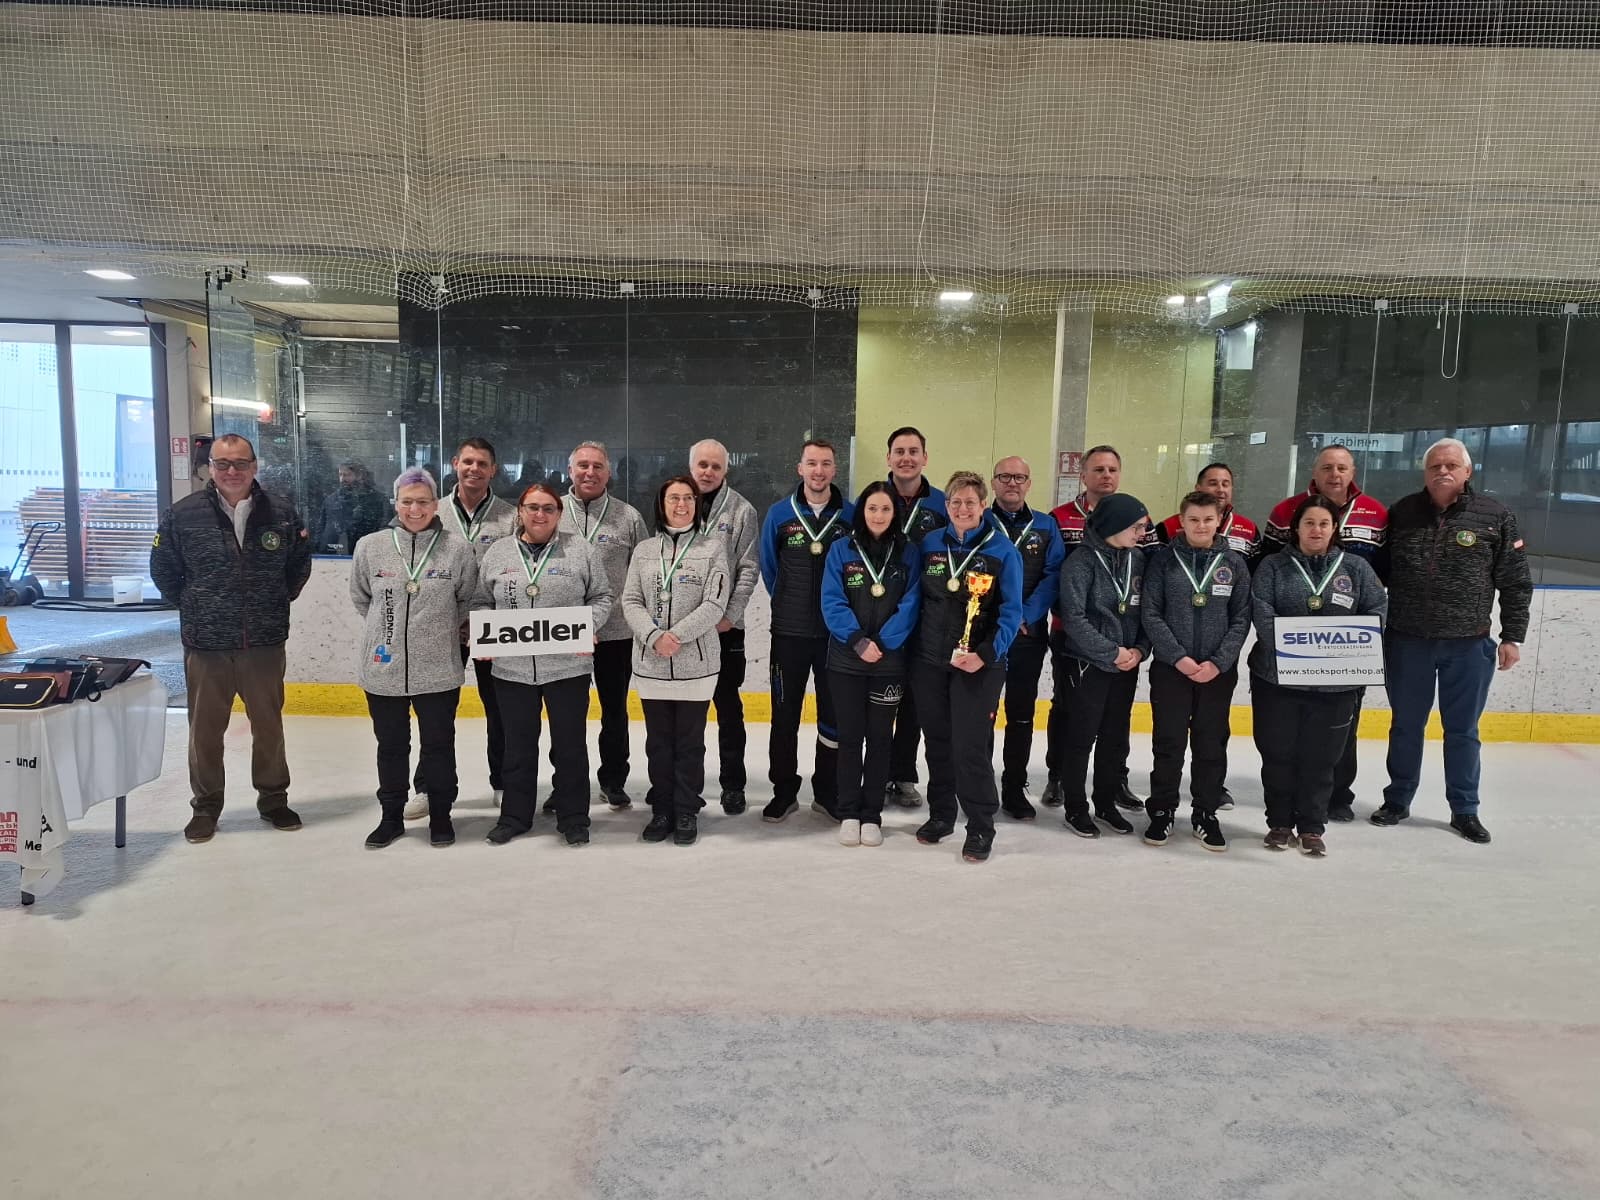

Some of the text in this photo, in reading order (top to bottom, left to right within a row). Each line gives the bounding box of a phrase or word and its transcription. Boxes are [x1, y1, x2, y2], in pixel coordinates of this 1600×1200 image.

[1330, 436, 1379, 448] Kabinen
[385, 588, 394, 645] PONGRATZ
[476, 620, 586, 645] Ladler
[1282, 631, 1373, 645] SEIWALD
[1278, 667, 1385, 676] www.stocksport-shop.at
[16, 756, 37, 769] und
